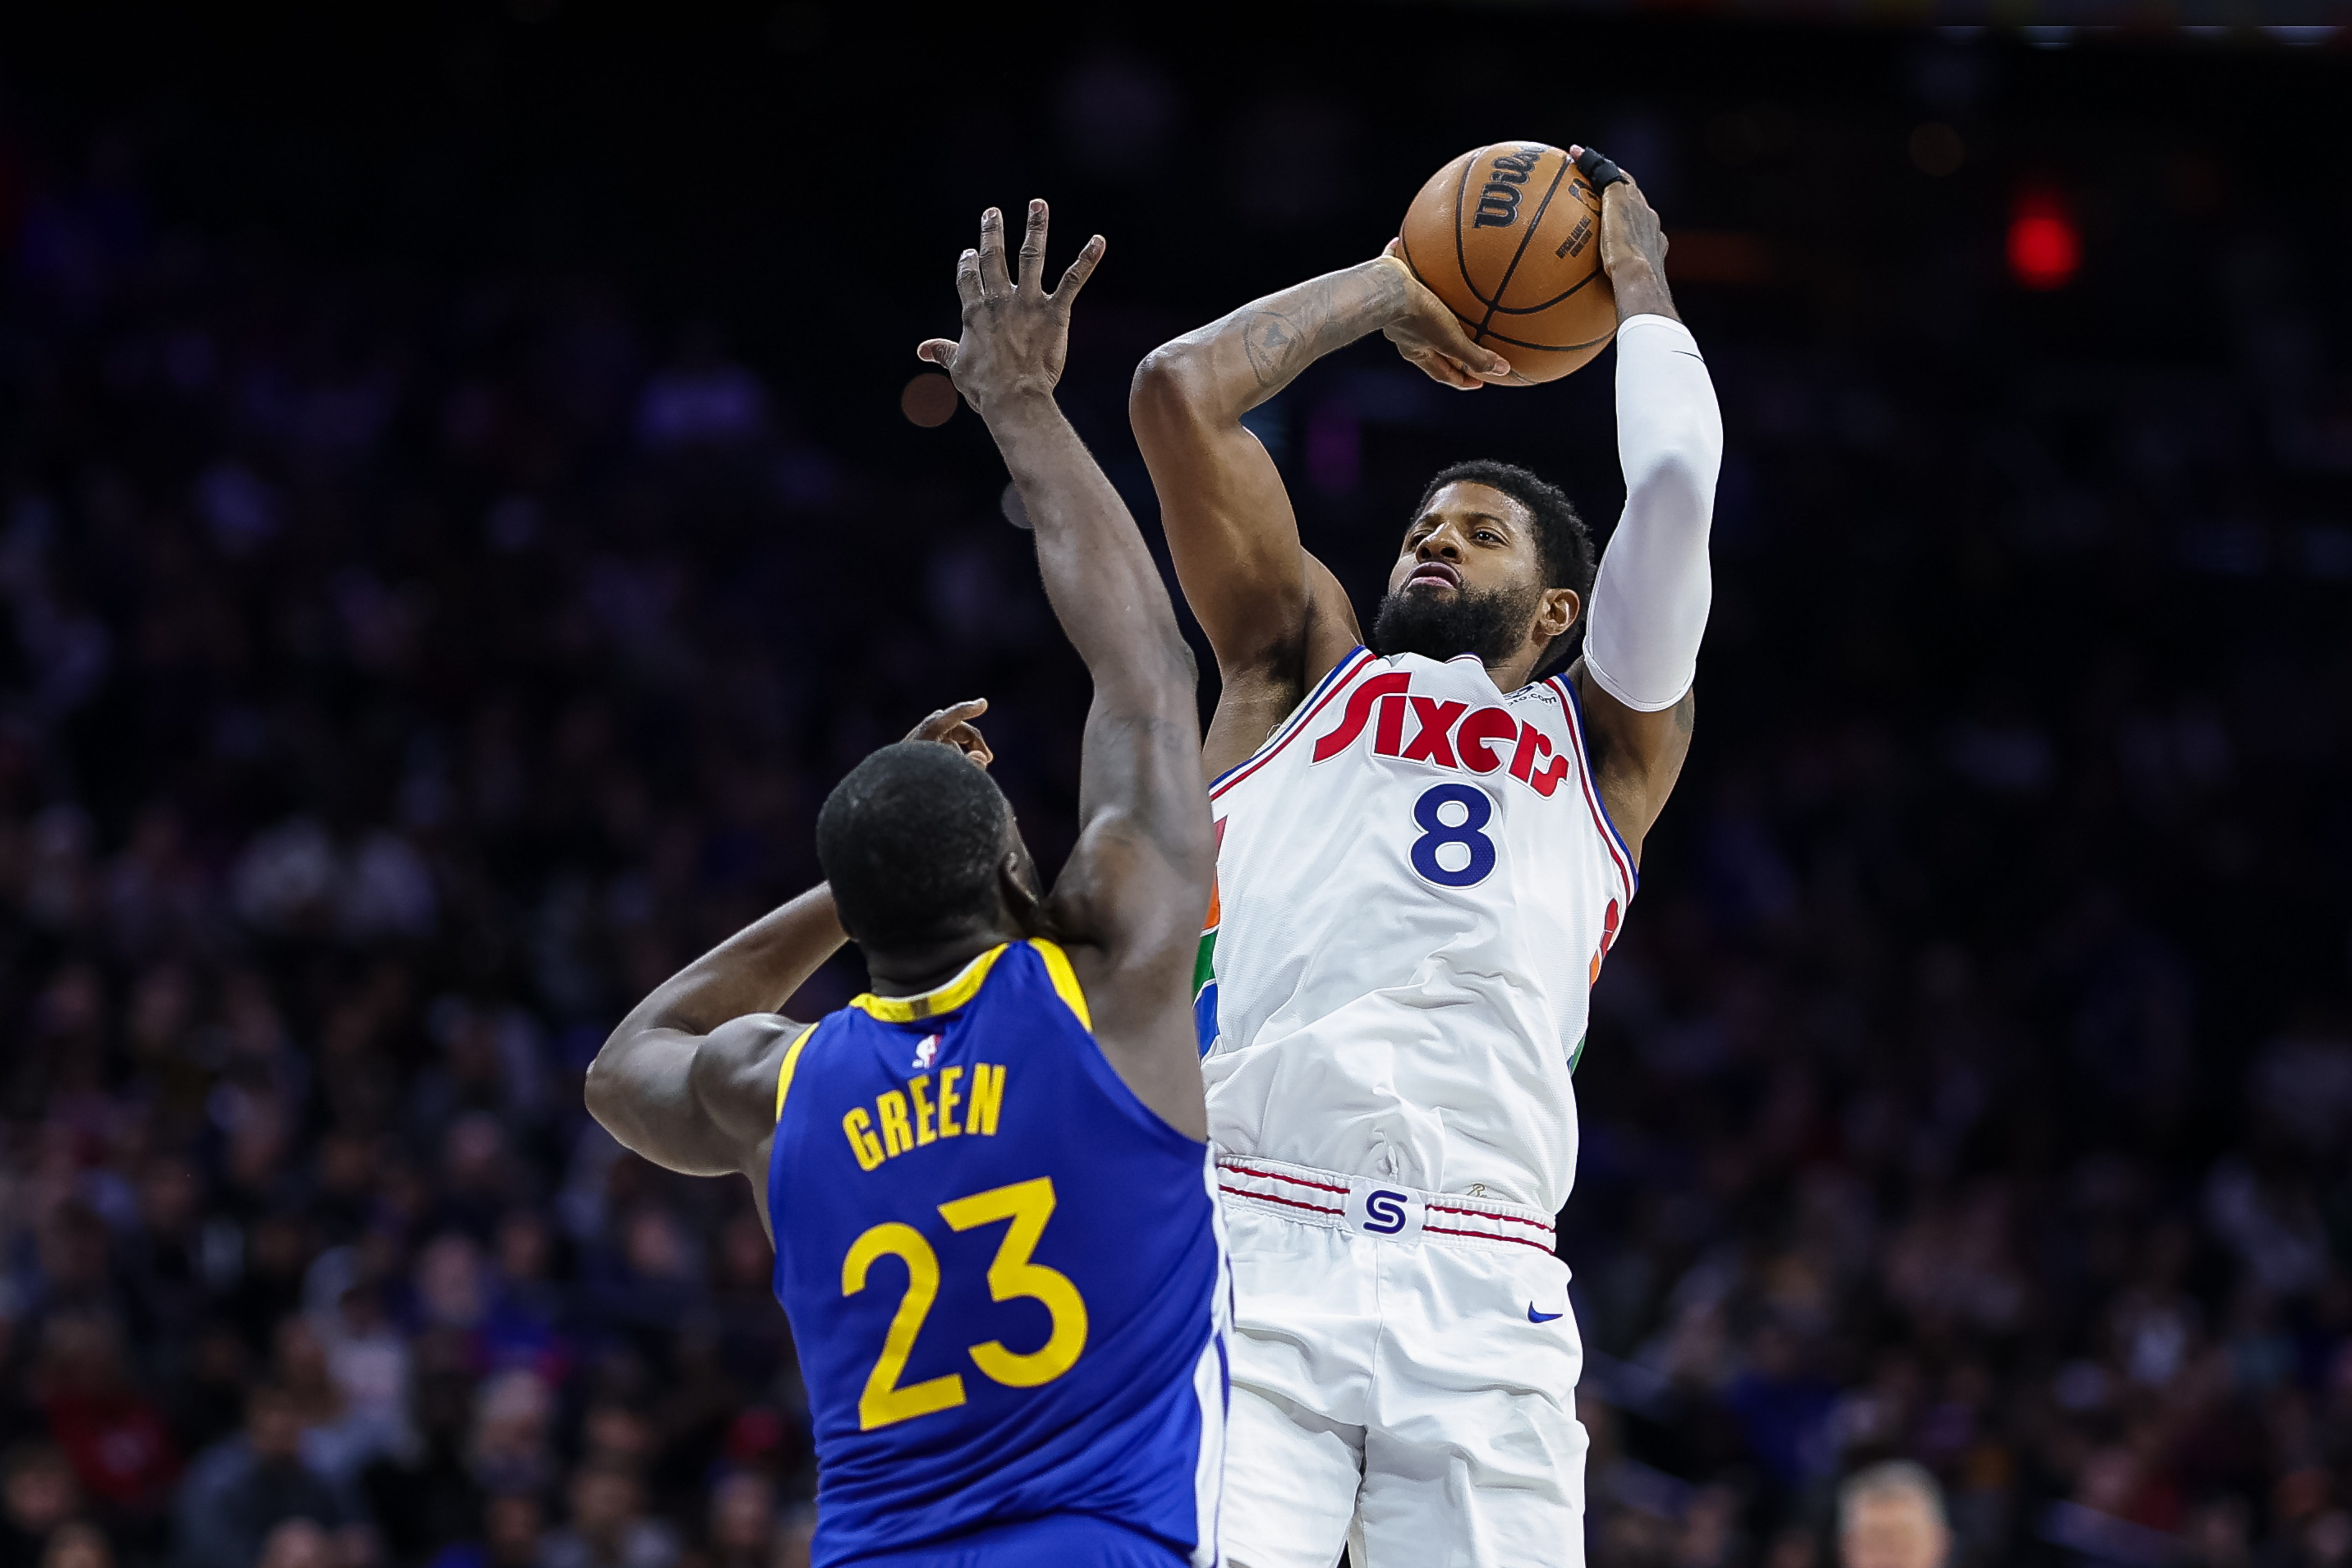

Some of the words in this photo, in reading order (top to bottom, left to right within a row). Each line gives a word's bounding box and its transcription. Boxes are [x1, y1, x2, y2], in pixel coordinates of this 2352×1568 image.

[1410, 783, 1496, 887] 8
[842, 1063, 1006, 1171] GREEN
[841, 1176, 1089, 1431] 23
